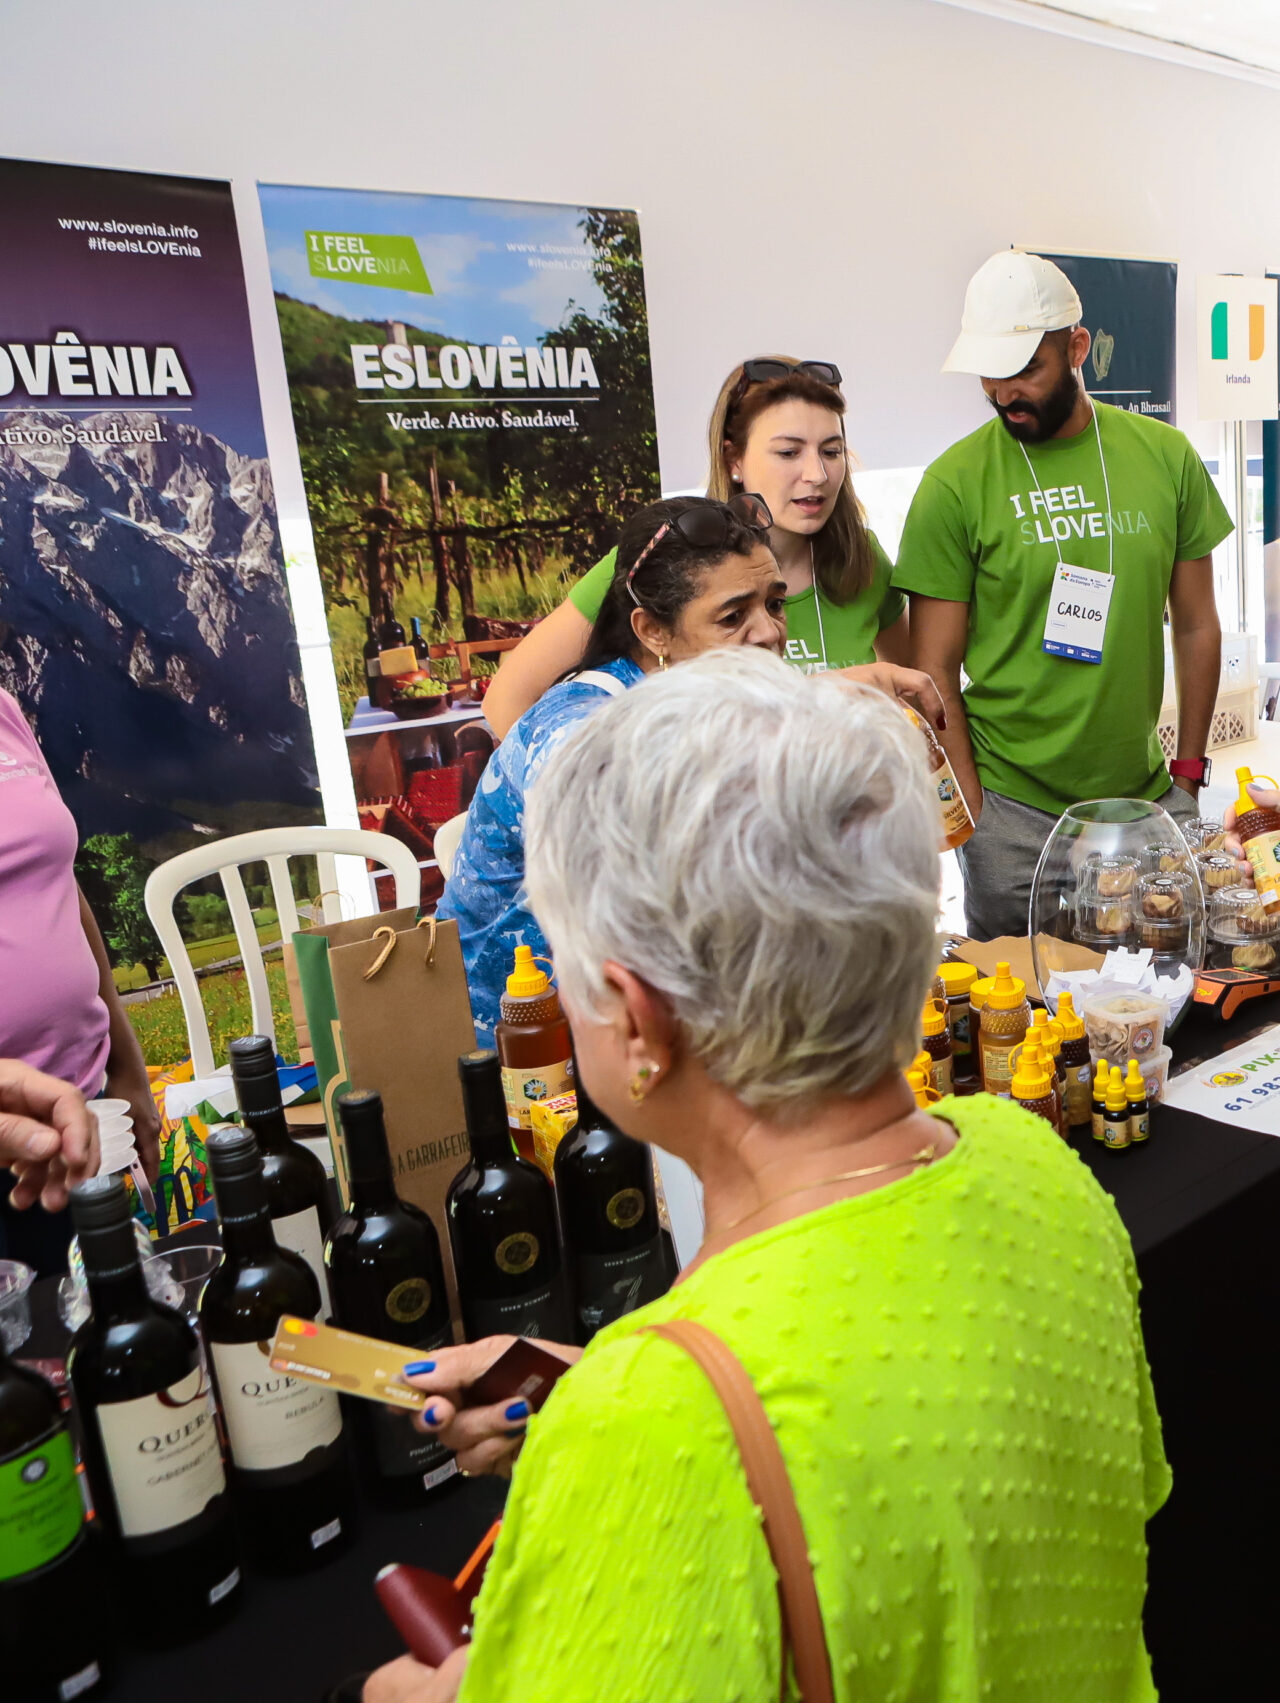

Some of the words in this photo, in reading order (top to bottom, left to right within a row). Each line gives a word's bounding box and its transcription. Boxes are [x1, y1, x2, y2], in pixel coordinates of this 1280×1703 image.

[58, 217, 199, 239] www.slovenia.info
[88, 237, 202, 257] #ifeelsLOVEnia
[309, 234, 320, 252] I
[323, 235, 371, 254] FEEL
[313, 254, 411, 275] SLOVENIA
[350, 335, 600, 389] ESLOVÊNIA
[1226, 374, 1251, 384] Irlanda
[1127, 402, 1139, 413] An
[1141, 401, 1171, 413] Bhrasail
[386, 411, 444, 431] Verde.
[447, 411, 499, 430] Ativo.
[502, 409, 579, 429] Saudável.
[0, 426, 57, 445] tivo.
[62, 422, 168, 444] Saudável.
[1009, 494, 1026, 518] I
[1028, 485, 1096, 515] FEEL
[1020, 510, 1152, 545] SLOVENIA
[1057, 602, 1102, 621] CARLOS
[1224, 1097, 1253, 1112] 61
[406, 1131, 471, 1172] GARRAFEIR
